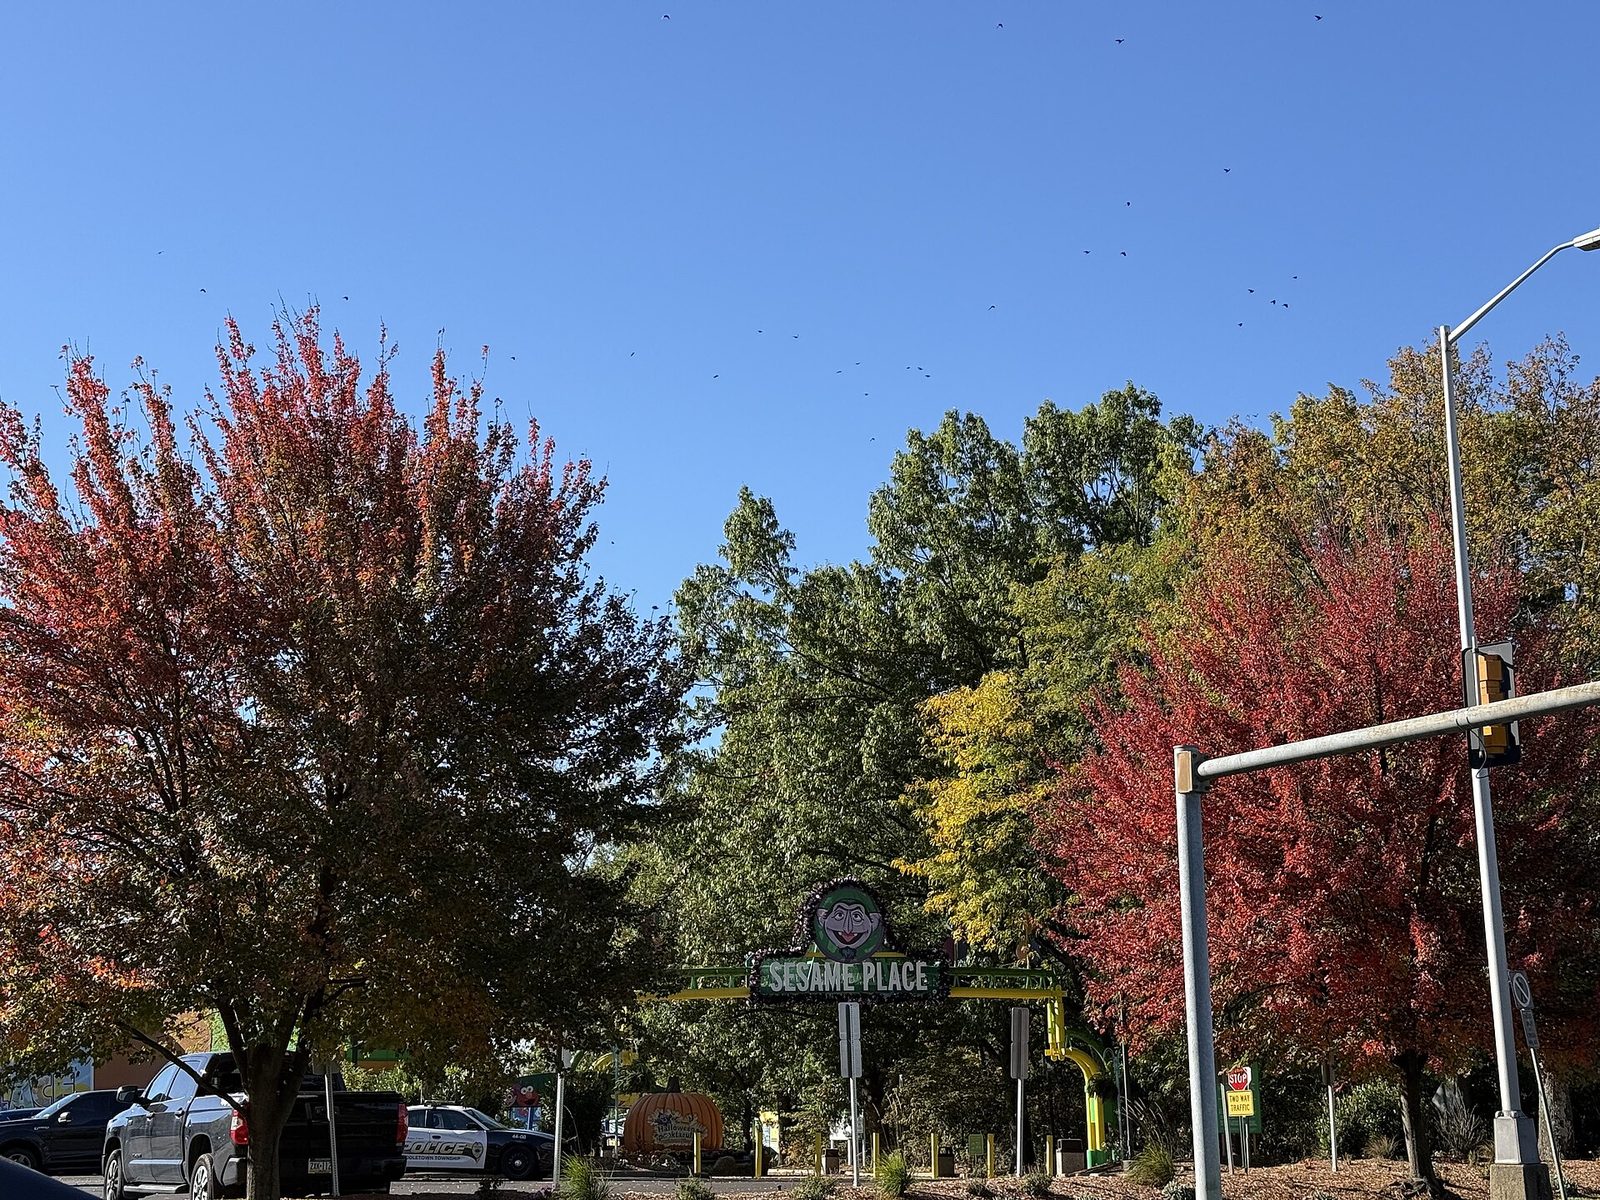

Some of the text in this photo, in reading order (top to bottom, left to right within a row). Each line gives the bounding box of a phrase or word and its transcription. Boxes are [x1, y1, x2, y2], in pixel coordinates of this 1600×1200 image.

[768, 961, 929, 992] SESAME PLACE
[1229, 1073, 1247, 1084] STOP
[1229, 1095, 1240, 1103] TWO
[1230, 1104, 1250, 1112] TRAFFIC
[404, 1142, 467, 1155] POLICE
